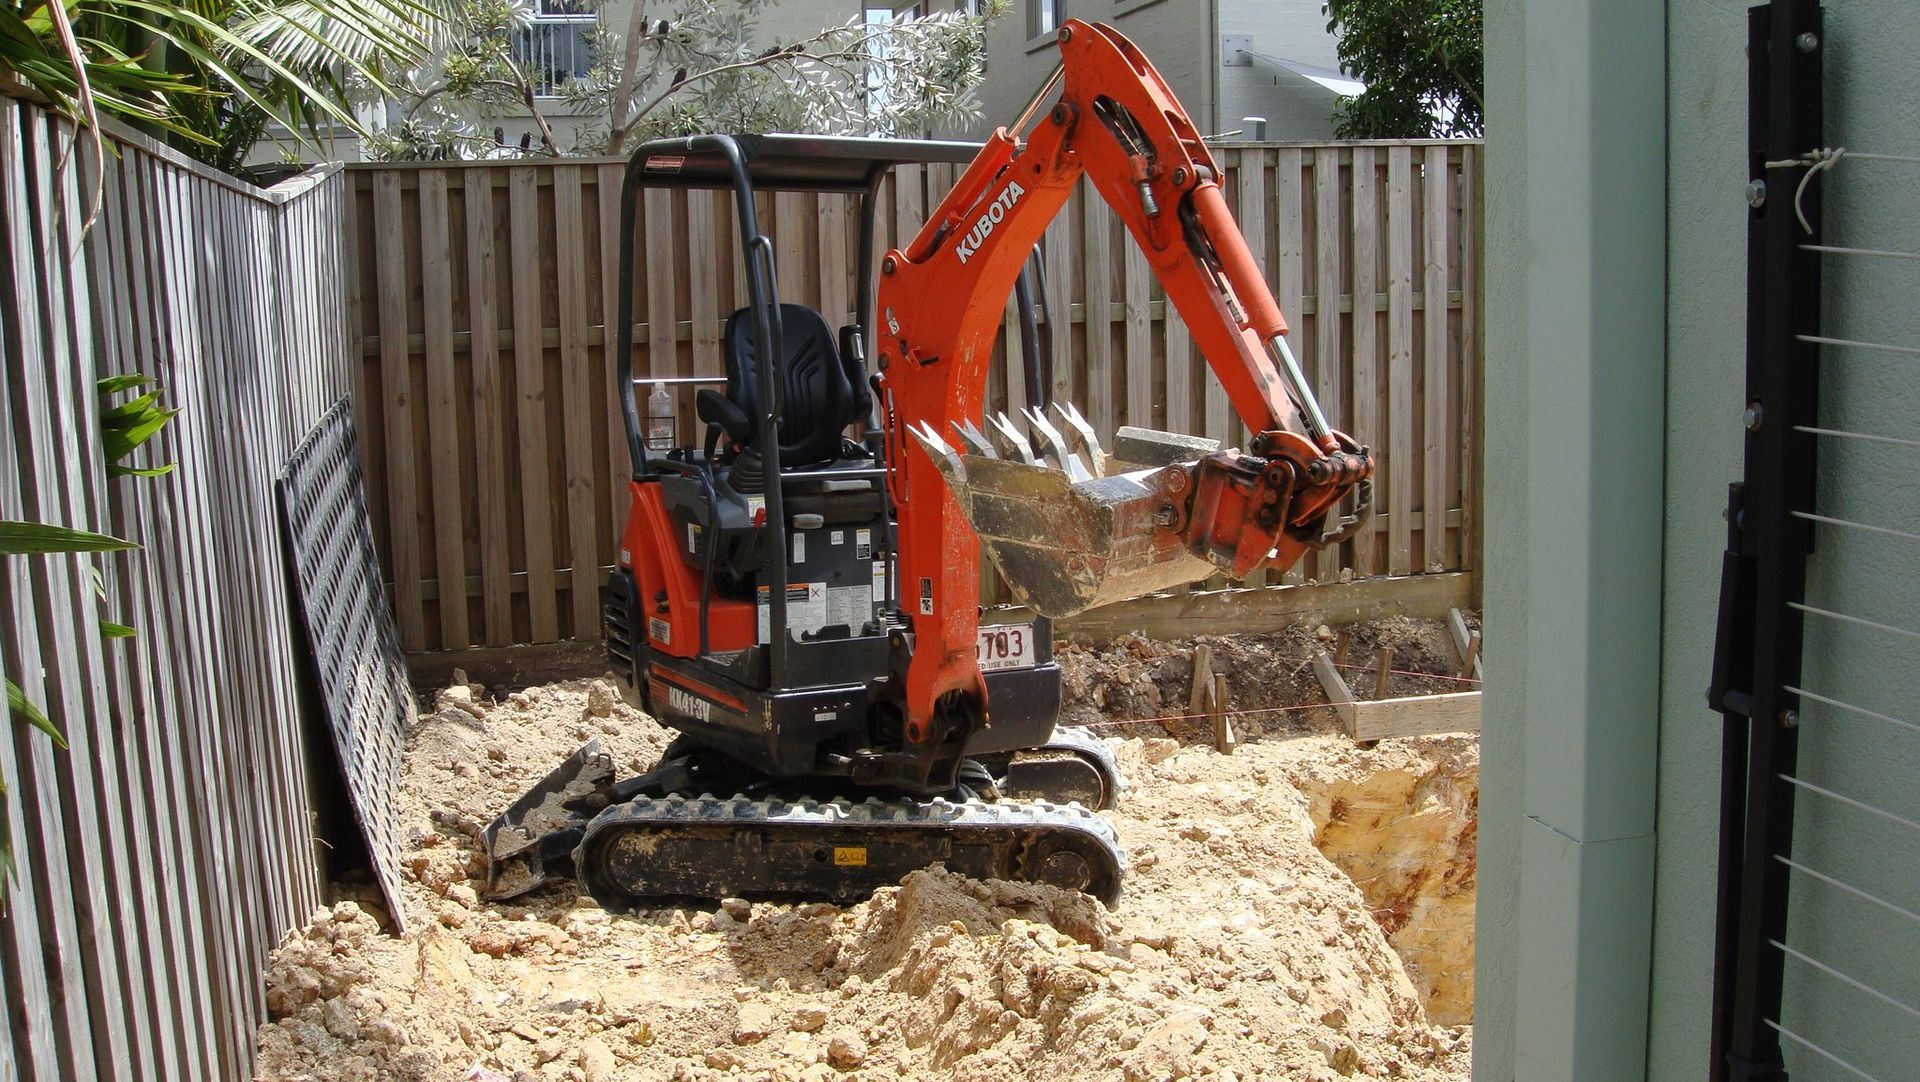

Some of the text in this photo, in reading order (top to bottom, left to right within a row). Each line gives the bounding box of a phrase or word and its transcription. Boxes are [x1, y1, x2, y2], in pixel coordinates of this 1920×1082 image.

[955, 180, 1025, 264] KUBOTA
[988, 661, 1001, 669] USE
[1004, 659, 1020, 668] ONLY
